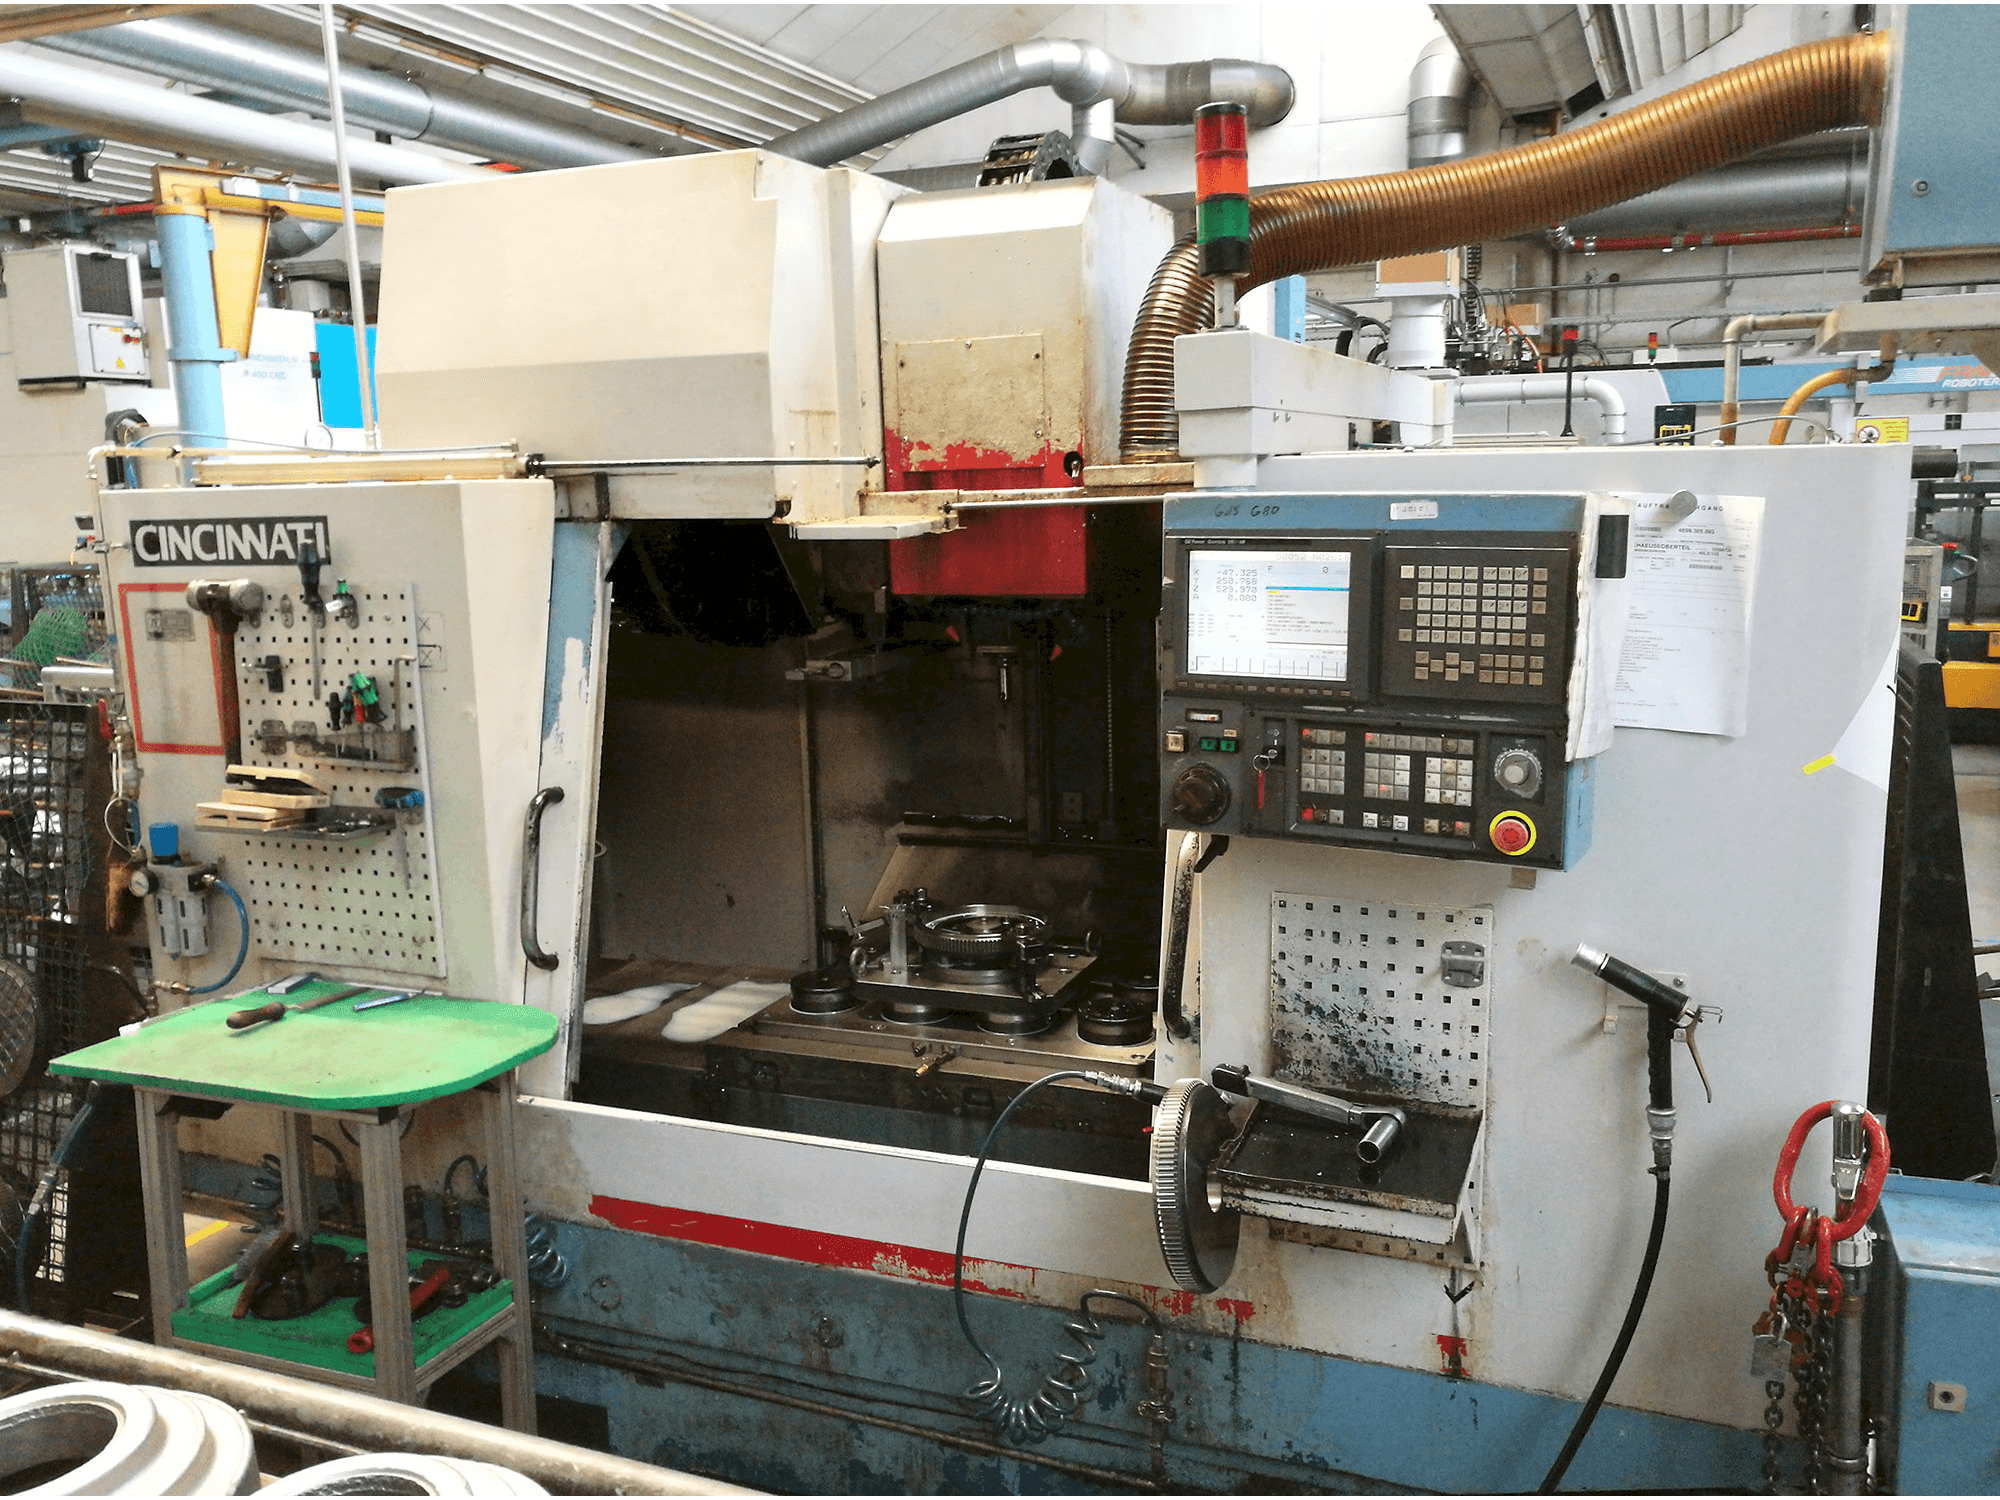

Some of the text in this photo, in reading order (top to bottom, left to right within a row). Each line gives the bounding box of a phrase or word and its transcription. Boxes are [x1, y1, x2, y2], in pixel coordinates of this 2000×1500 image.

[1251, 505, 1280, 517] G80
[135, 522, 326, 562] CINCINNATI
[1216, 568, 1258, 577] -47.325
[1216, 577, 1258, 585] 250.768
[1193, 584, 1199, 592] Z
[1215, 585, 1258, 594] 529.970
[1227, 594, 1257, 602] 0.000
